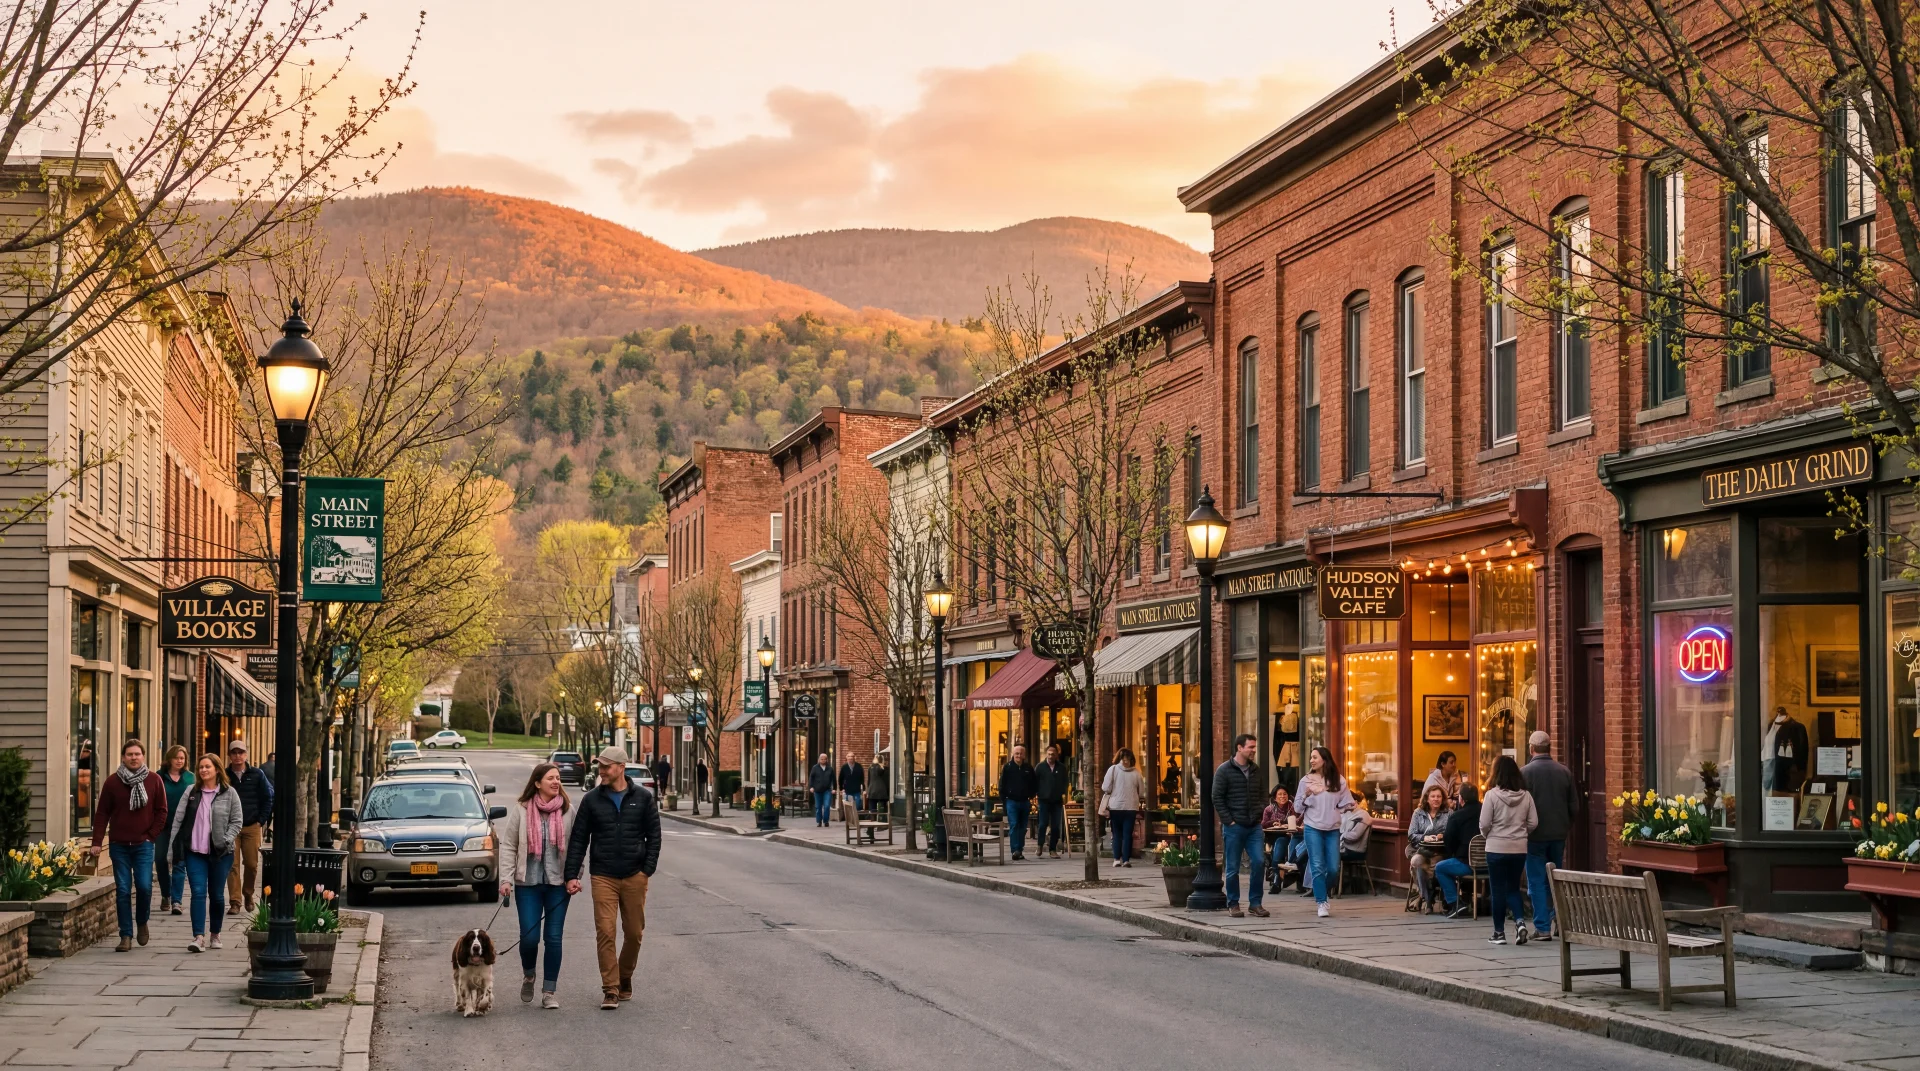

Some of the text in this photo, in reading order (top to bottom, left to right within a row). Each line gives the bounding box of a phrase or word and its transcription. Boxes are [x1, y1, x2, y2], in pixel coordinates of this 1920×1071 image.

[1705, 446, 1868, 500] THE DAILY GRIND
[319, 496, 370, 512] MAIN
[311, 513, 378, 529] STREET
[1228, 577, 1247, 596] MAIN
[1248, 572, 1276, 593] STREET
[1326, 571, 1400, 584] HUDSON
[1329, 586, 1396, 599] VALLEY
[167, 599, 266, 617] VILLAGE
[1121, 600, 1196, 626] MAIN STREET ANTIQUES
[1339, 601, 1386, 614] CAFE
[176, 621, 257, 639] BOOKS
[1679, 639, 1725, 671] OPEN
